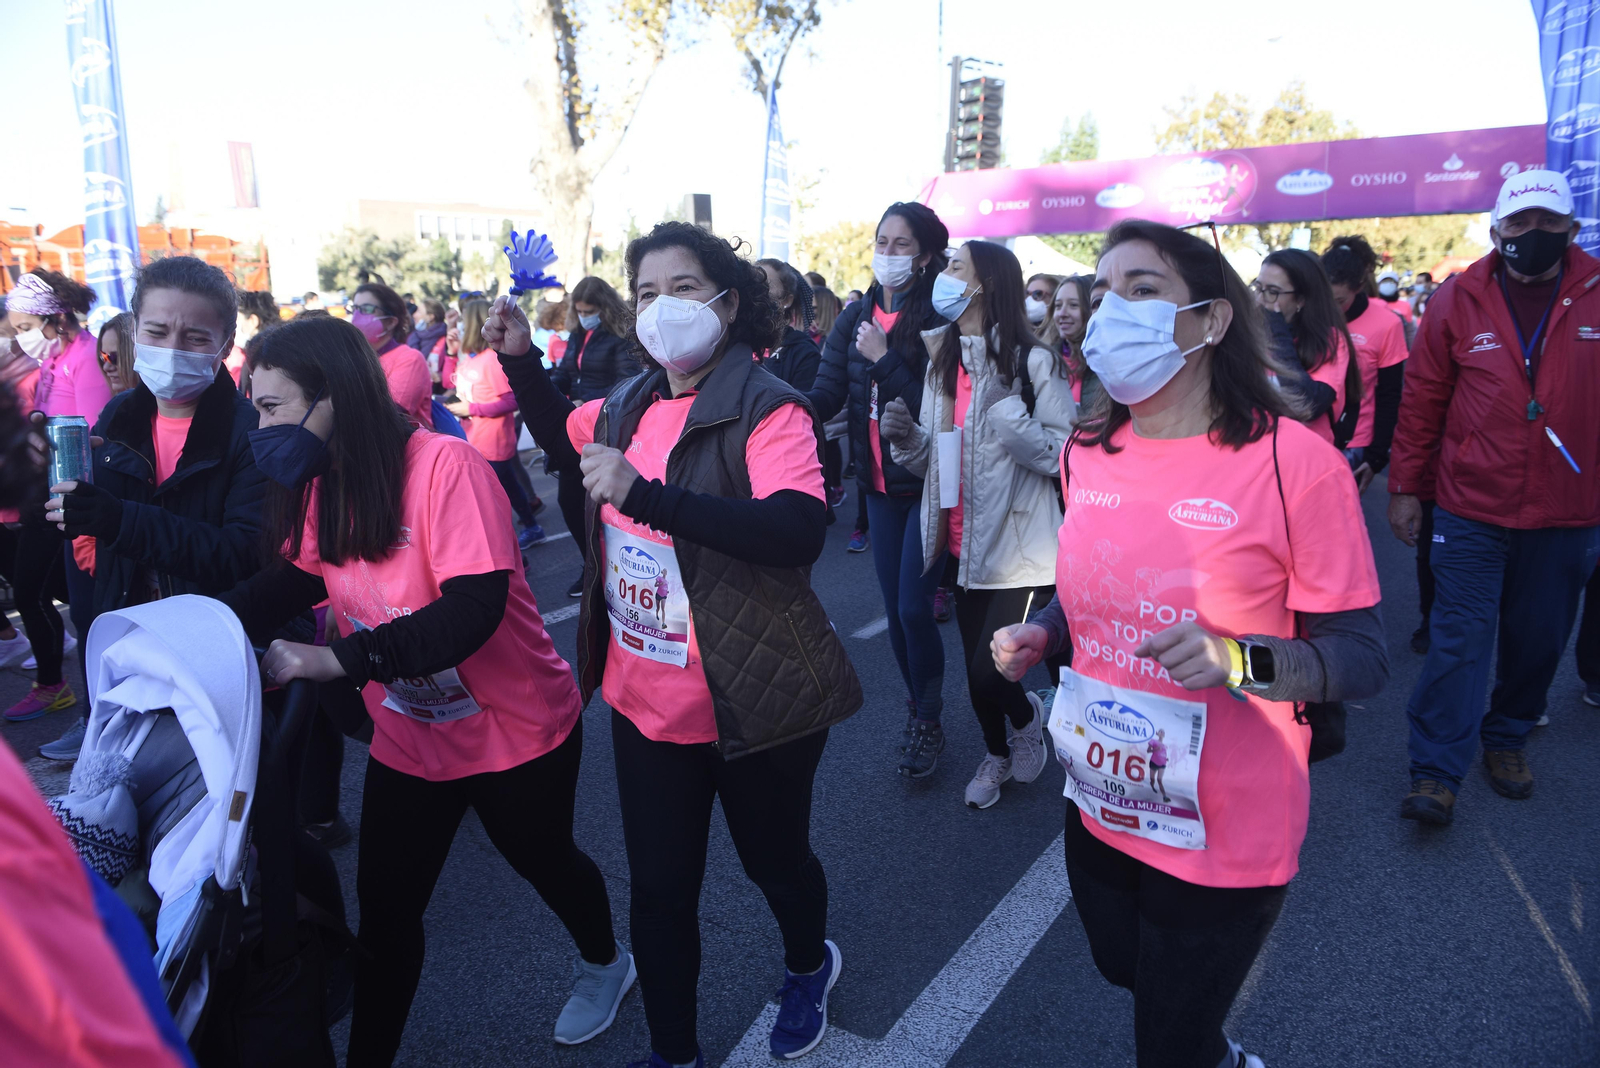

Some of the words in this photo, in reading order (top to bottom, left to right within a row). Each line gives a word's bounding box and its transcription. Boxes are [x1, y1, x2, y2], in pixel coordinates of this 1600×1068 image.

[1351, 171, 1407, 187] OYSHO
[1424, 169, 1481, 184] Santander
[995, 200, 1030, 211] ZURICH
[1042, 195, 1086, 209] OYSHO
[1074, 488, 1121, 509] OYSHO
[1172, 504, 1232, 526] ASTURIANA
[620, 552, 655, 576] ASTURIANA
[619, 577, 654, 610] 016
[385, 606, 412, 618] POR
[625, 607, 639, 622] 156
[1139, 600, 1198, 625] POR
[626, 620, 635, 629] DE
[634, 624, 643, 633] LA
[643, 627, 667, 639] MUJER
[658, 648, 682, 657] ZURICH
[426, 698, 449, 706] MUJER
[448, 704, 470, 714] ZURICH
[1089, 708, 1147, 739] ASTURIANA
[1086, 741, 1146, 783] 016
[1103, 779, 1125, 796] 109
[1075, 779, 1108, 801] CARRERA
[1108, 793, 1120, 805] DE
[1121, 800, 1135, 810] LA
[1137, 801, 1172, 815] MUJER
[1162, 824, 1193, 839] ZURICH
